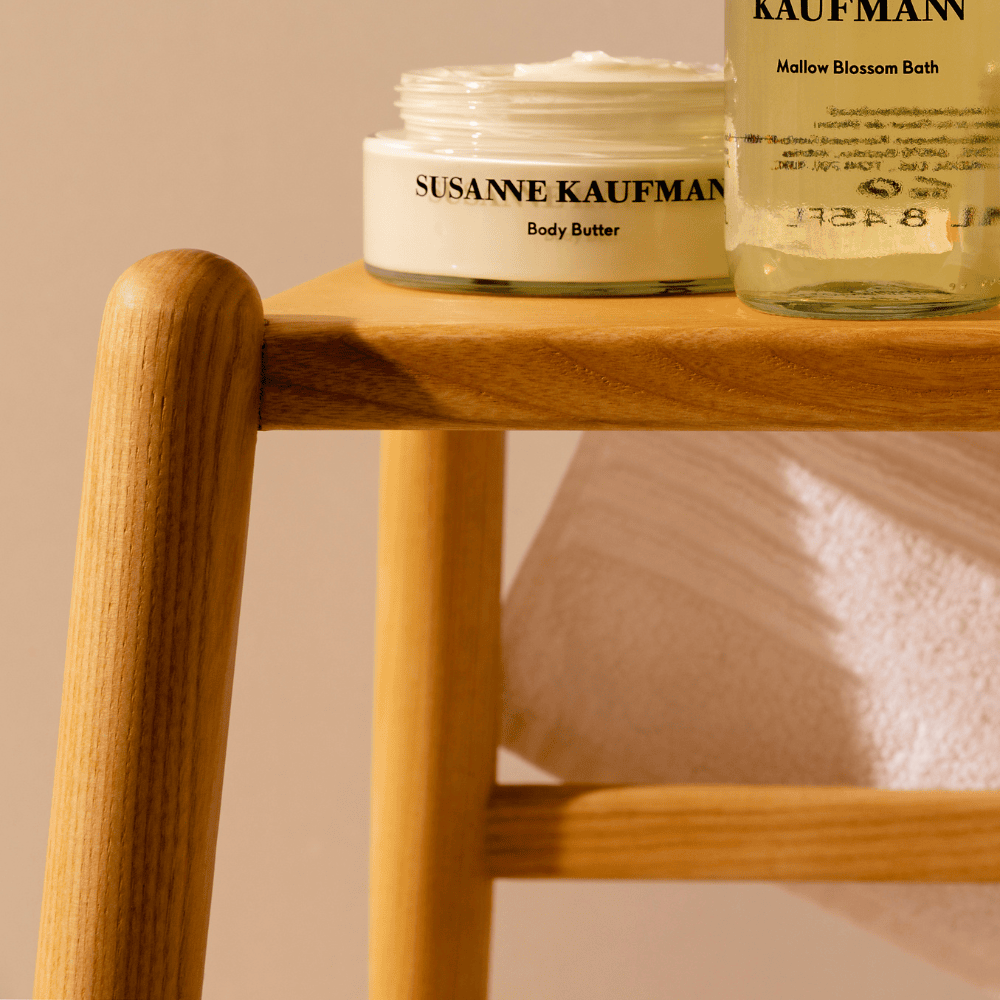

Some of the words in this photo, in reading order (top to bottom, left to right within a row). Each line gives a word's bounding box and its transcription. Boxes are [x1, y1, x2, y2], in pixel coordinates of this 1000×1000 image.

[776, 58, 830, 75] Mallow
[833, 59, 899, 75] Blossom
[902, 59, 939, 75] Bath
[415, 174, 548, 203] SUSANNE
[555, 177, 725, 204] KAUFMAN
[527, 221, 568, 240] Body
[571, 221, 621, 238] Butter
